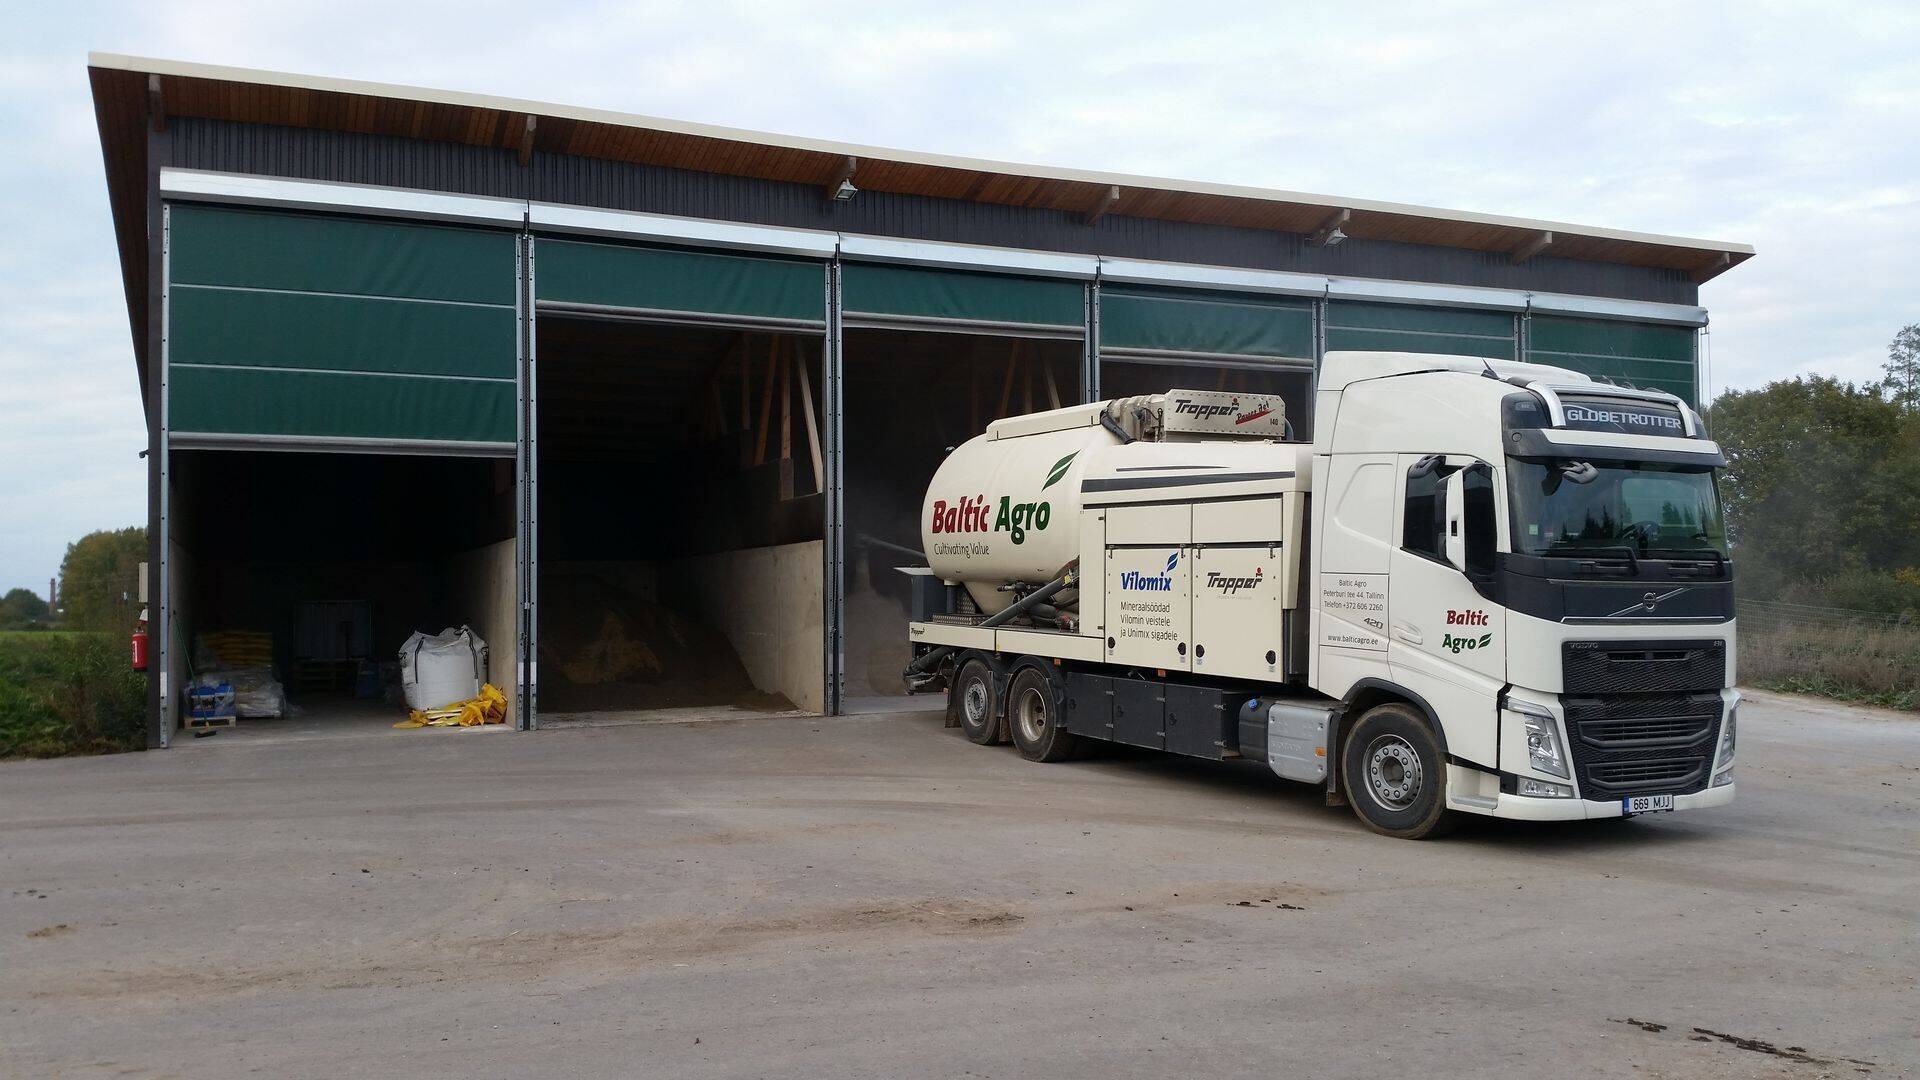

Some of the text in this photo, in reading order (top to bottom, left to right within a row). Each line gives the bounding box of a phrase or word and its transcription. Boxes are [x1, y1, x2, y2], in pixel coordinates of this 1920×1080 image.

[1175, 399, 1239, 420] Tropper
[1567, 410, 1681, 429] GLOBETROTTER
[932, 494, 1051, 545] Baltic Agro
[934, 542, 990, 558] Cultivating Value
[1121, 571, 1172, 591] Vilomix
[1207, 572, 1263, 594] Tropper
[1338, 579, 1368, 588] Baltic Agro
[1366, 591, 1385, 600] Tallinn
[1120, 601, 1170, 613] Mineraalsöödad
[1324, 601, 1342, 610] Telefon
[1342, 602, 1356, 610] +372
[1369, 603, 1384, 612] 2260
[1120, 614, 1171, 627] Vilomin veistele
[1363, 617, 1384, 630] 420
[1446, 609, 1489, 627] Baltic
[1120, 627, 1178, 641] ja Unimix sigadele
[1327, 634, 1379, 646] www.balticagro.ee
[1442, 633, 1477, 654] Agro
[1633, 796, 1670, 810] 669 MJJ
